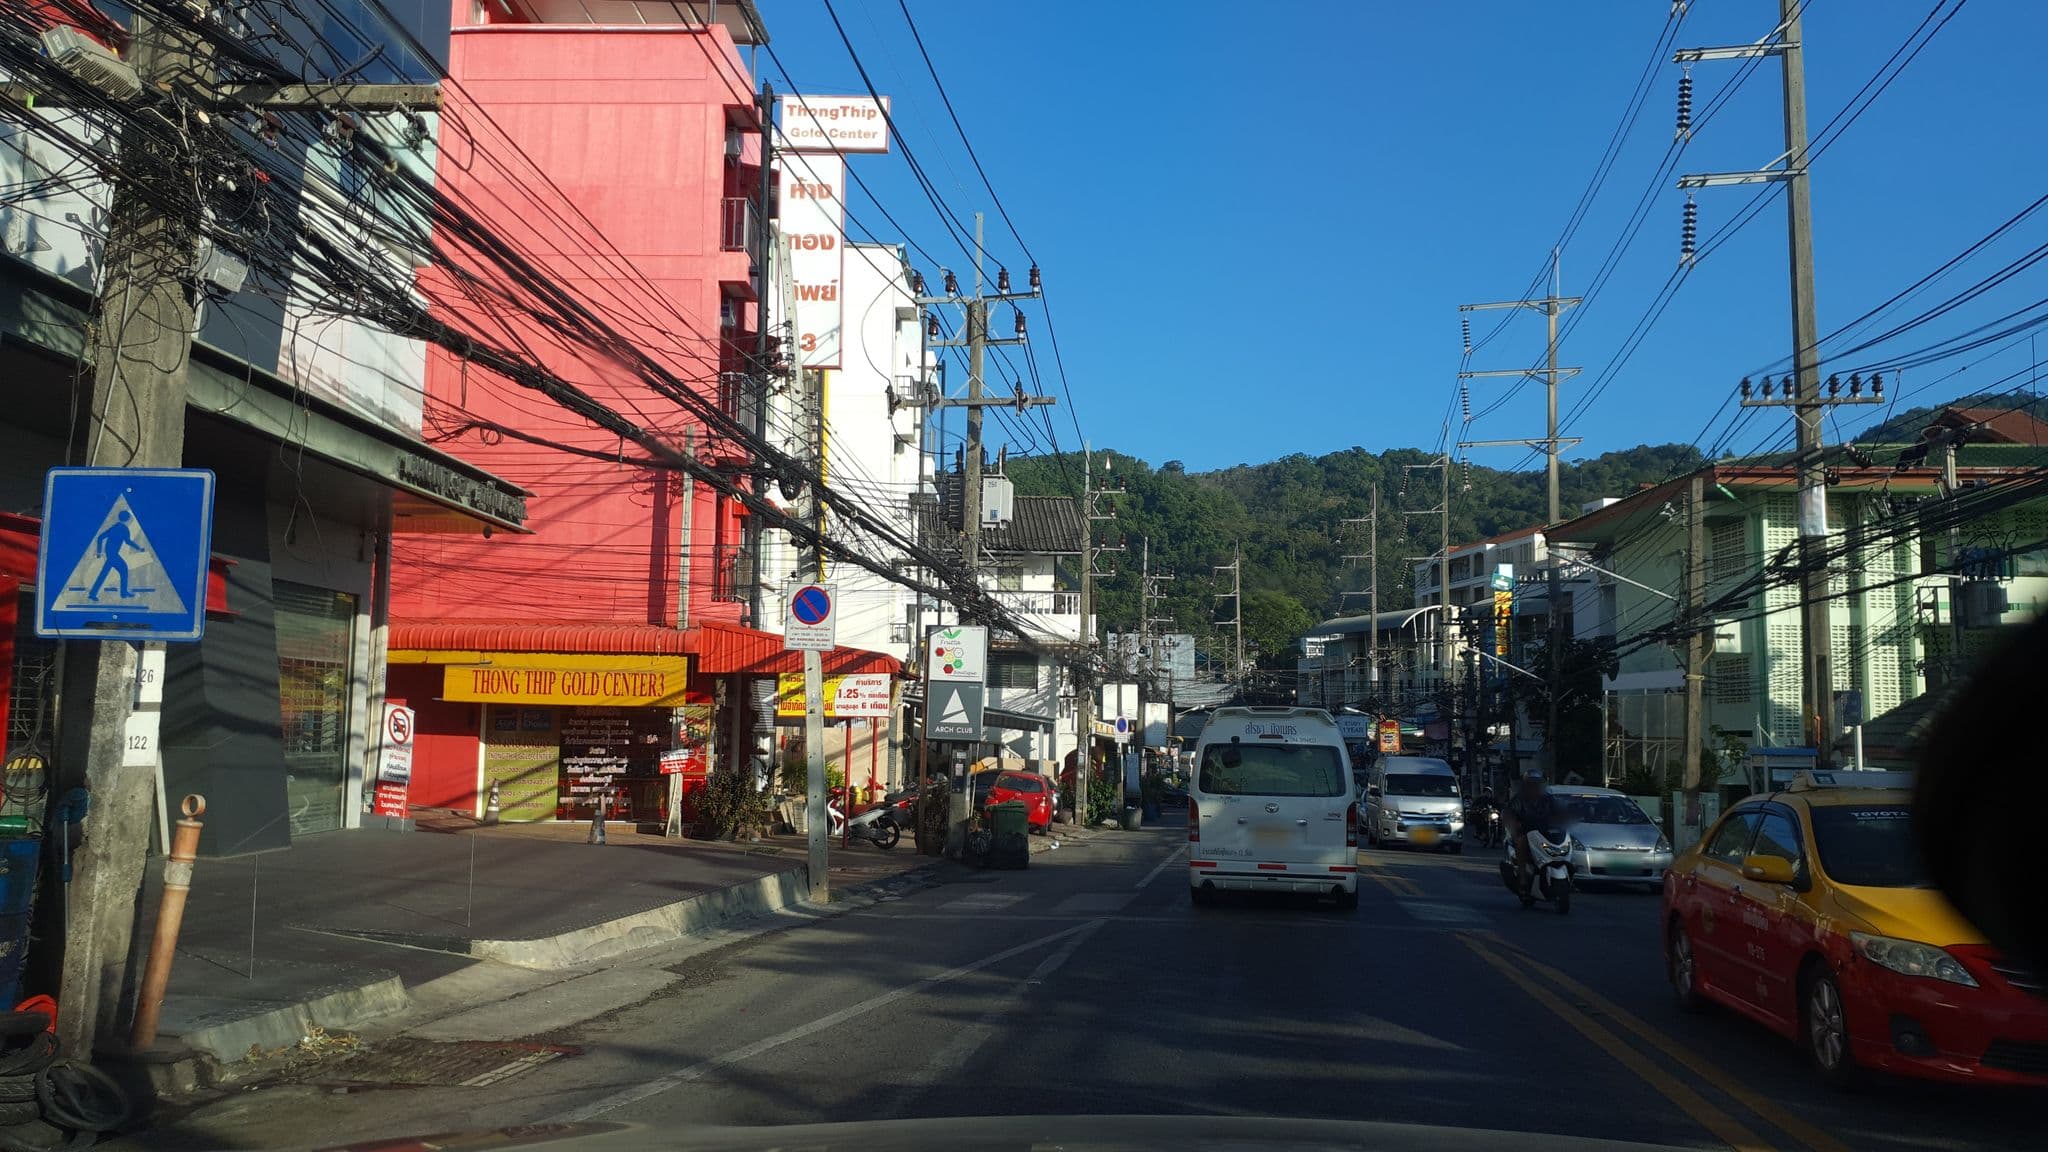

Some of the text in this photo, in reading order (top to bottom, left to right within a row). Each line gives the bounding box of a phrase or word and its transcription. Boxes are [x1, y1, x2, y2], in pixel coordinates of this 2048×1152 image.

[786, 104, 877, 120] ThongThip
[790, 127, 878, 139] Gold Center
[801, 333, 817, 352] 3
[473, 669, 519, 694] THONG
[525, 670, 556, 695] THIP
[561, 671, 600, 696] GOLD
[935, 726, 954, 734] ARCH
[129, 735, 147, 750] 122
